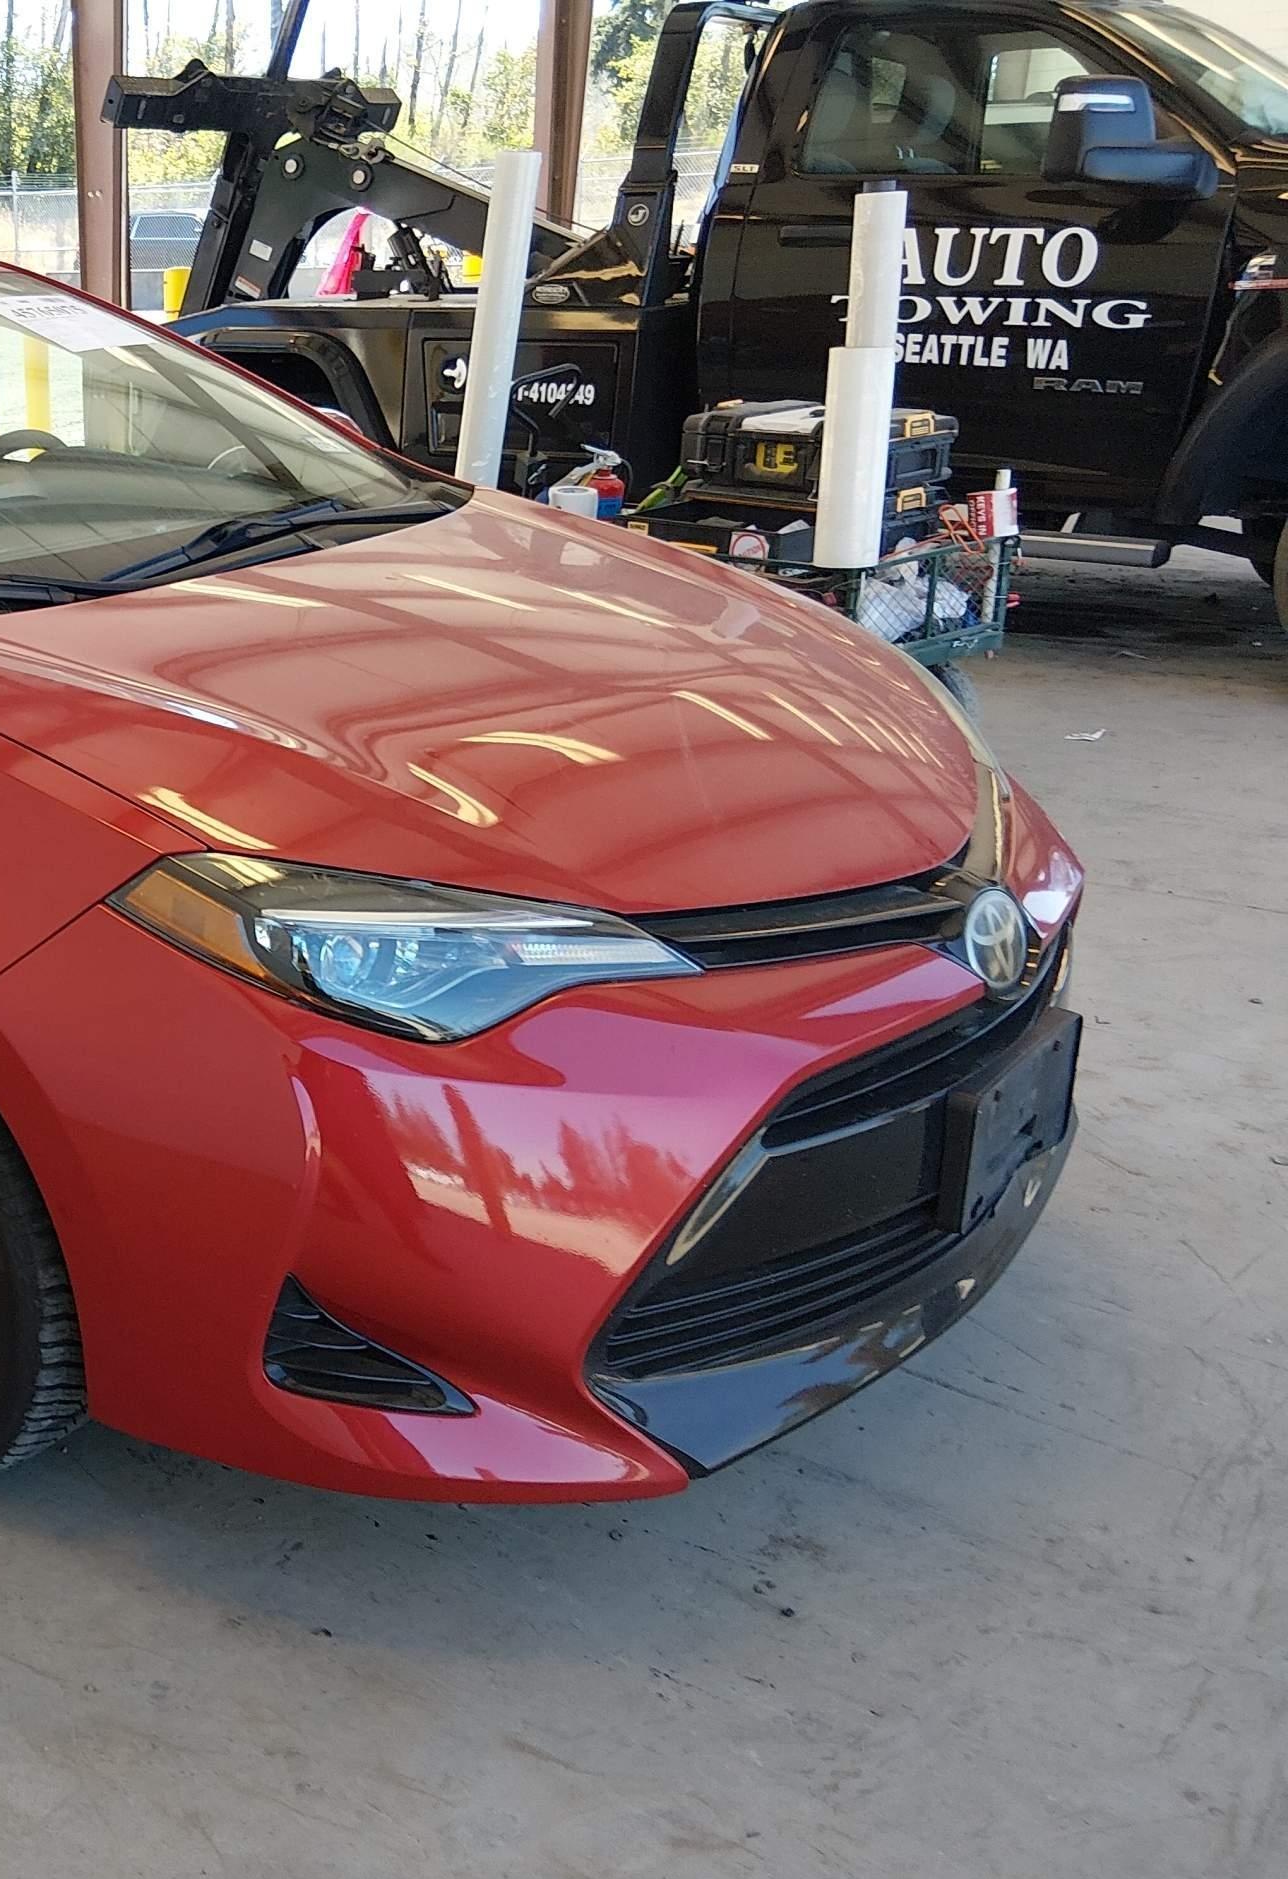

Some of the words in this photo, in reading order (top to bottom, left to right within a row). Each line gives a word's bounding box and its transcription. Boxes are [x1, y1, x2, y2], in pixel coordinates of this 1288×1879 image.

[895, 333, 1010, 367] SEATTLE
[1026, 338, 1069, 370] WA
[1032, 376, 1144, 395] RAM
[975, 496, 987, 522] KEYS
[977, 525, 988, 536] IN
